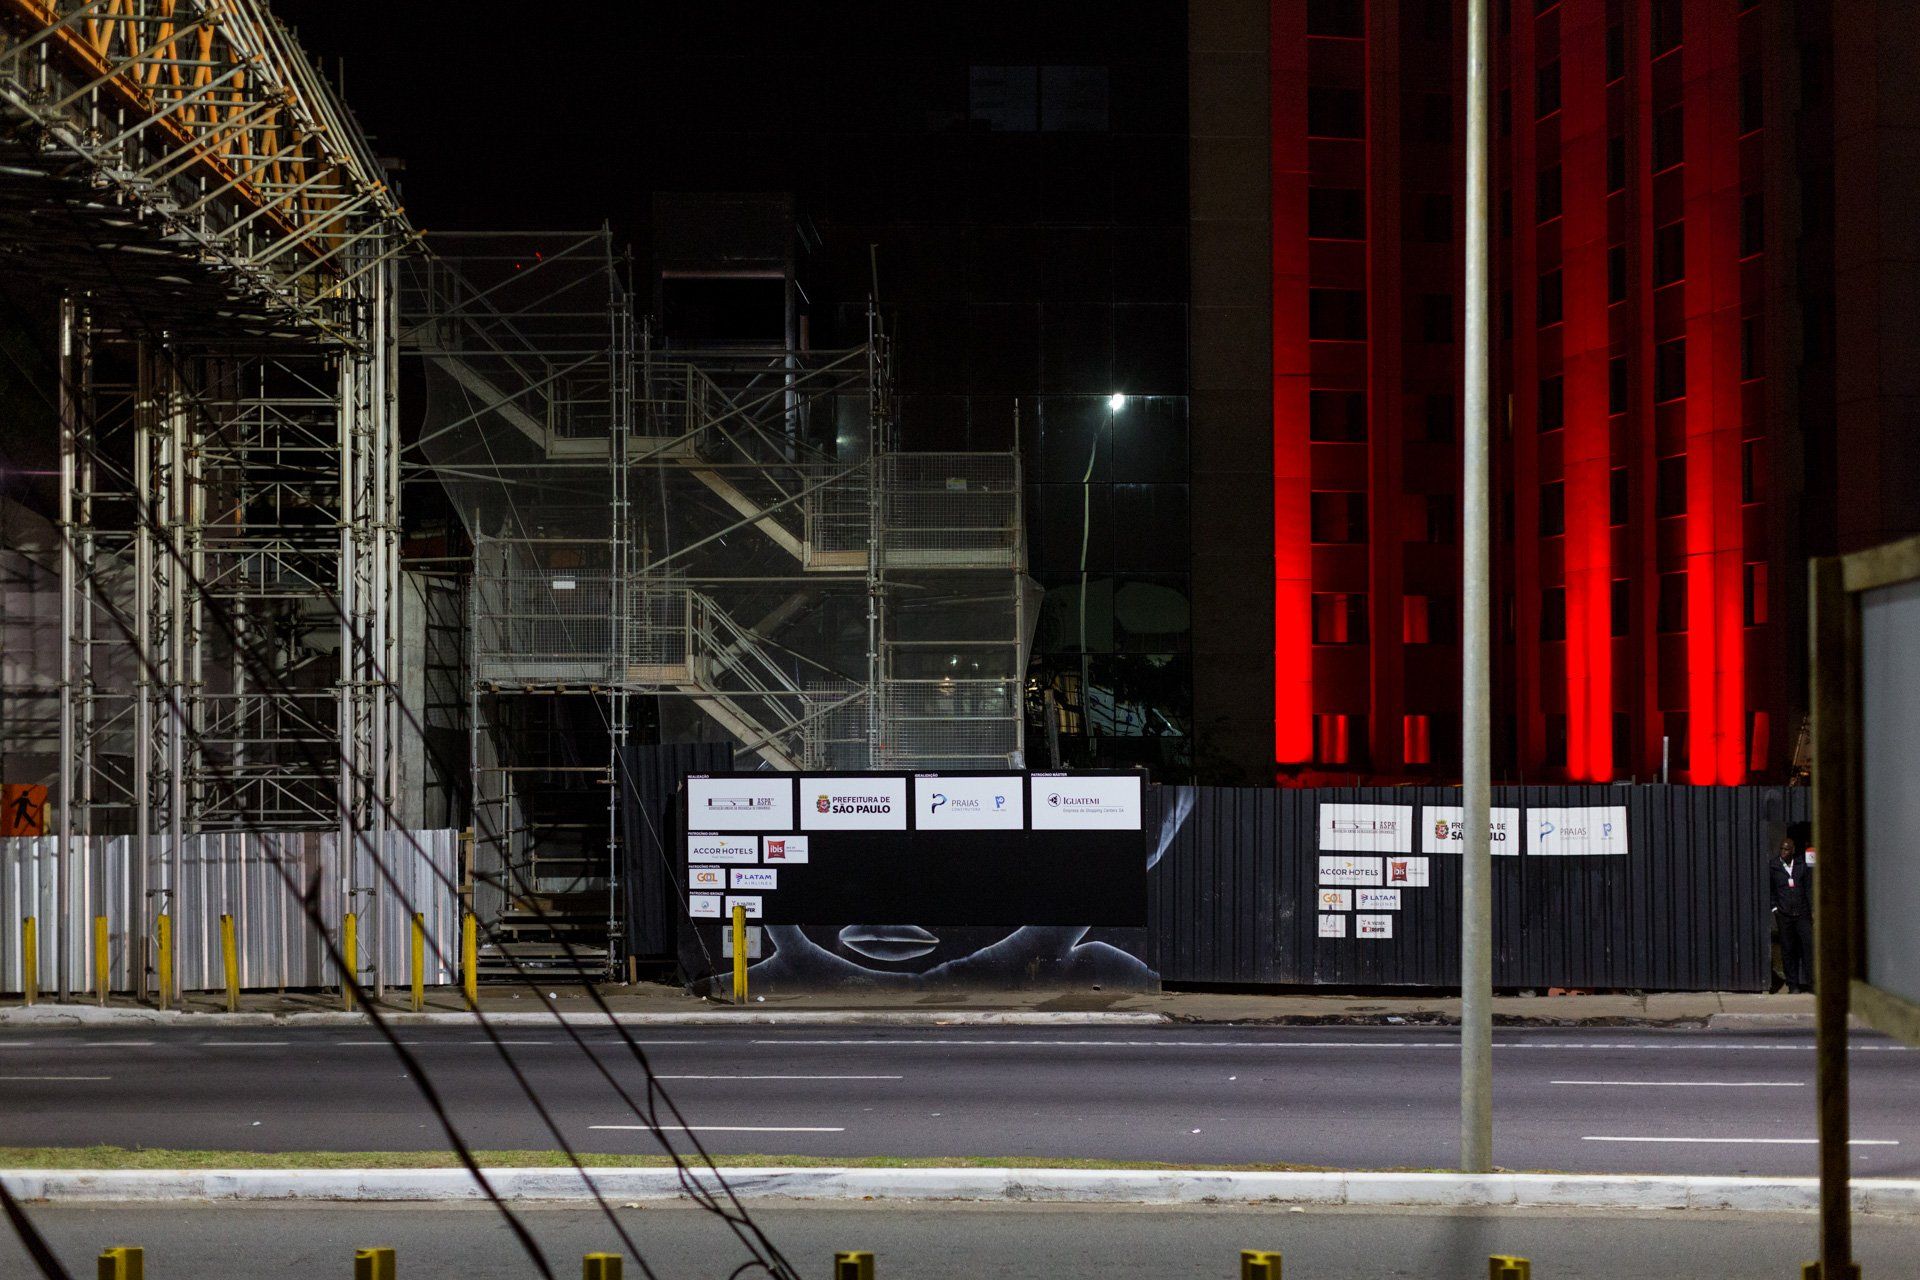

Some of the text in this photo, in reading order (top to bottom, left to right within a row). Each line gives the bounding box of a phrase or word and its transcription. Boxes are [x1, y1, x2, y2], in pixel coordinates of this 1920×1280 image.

[951, 799, 979, 807] PRAIAS
[832, 804, 891, 814] SÃO PAULO
[1451, 830, 1464, 841] SÃ
[1560, 827, 1587, 836] PRAIAS
[693, 847, 754, 855] ACCOR HOTELS
[770, 845, 783, 853] ibis
[1320, 868, 1379, 876] ACCOR HOTELS
[697, 872, 718, 882] GOL
[1323, 893, 1343, 903] GOL
